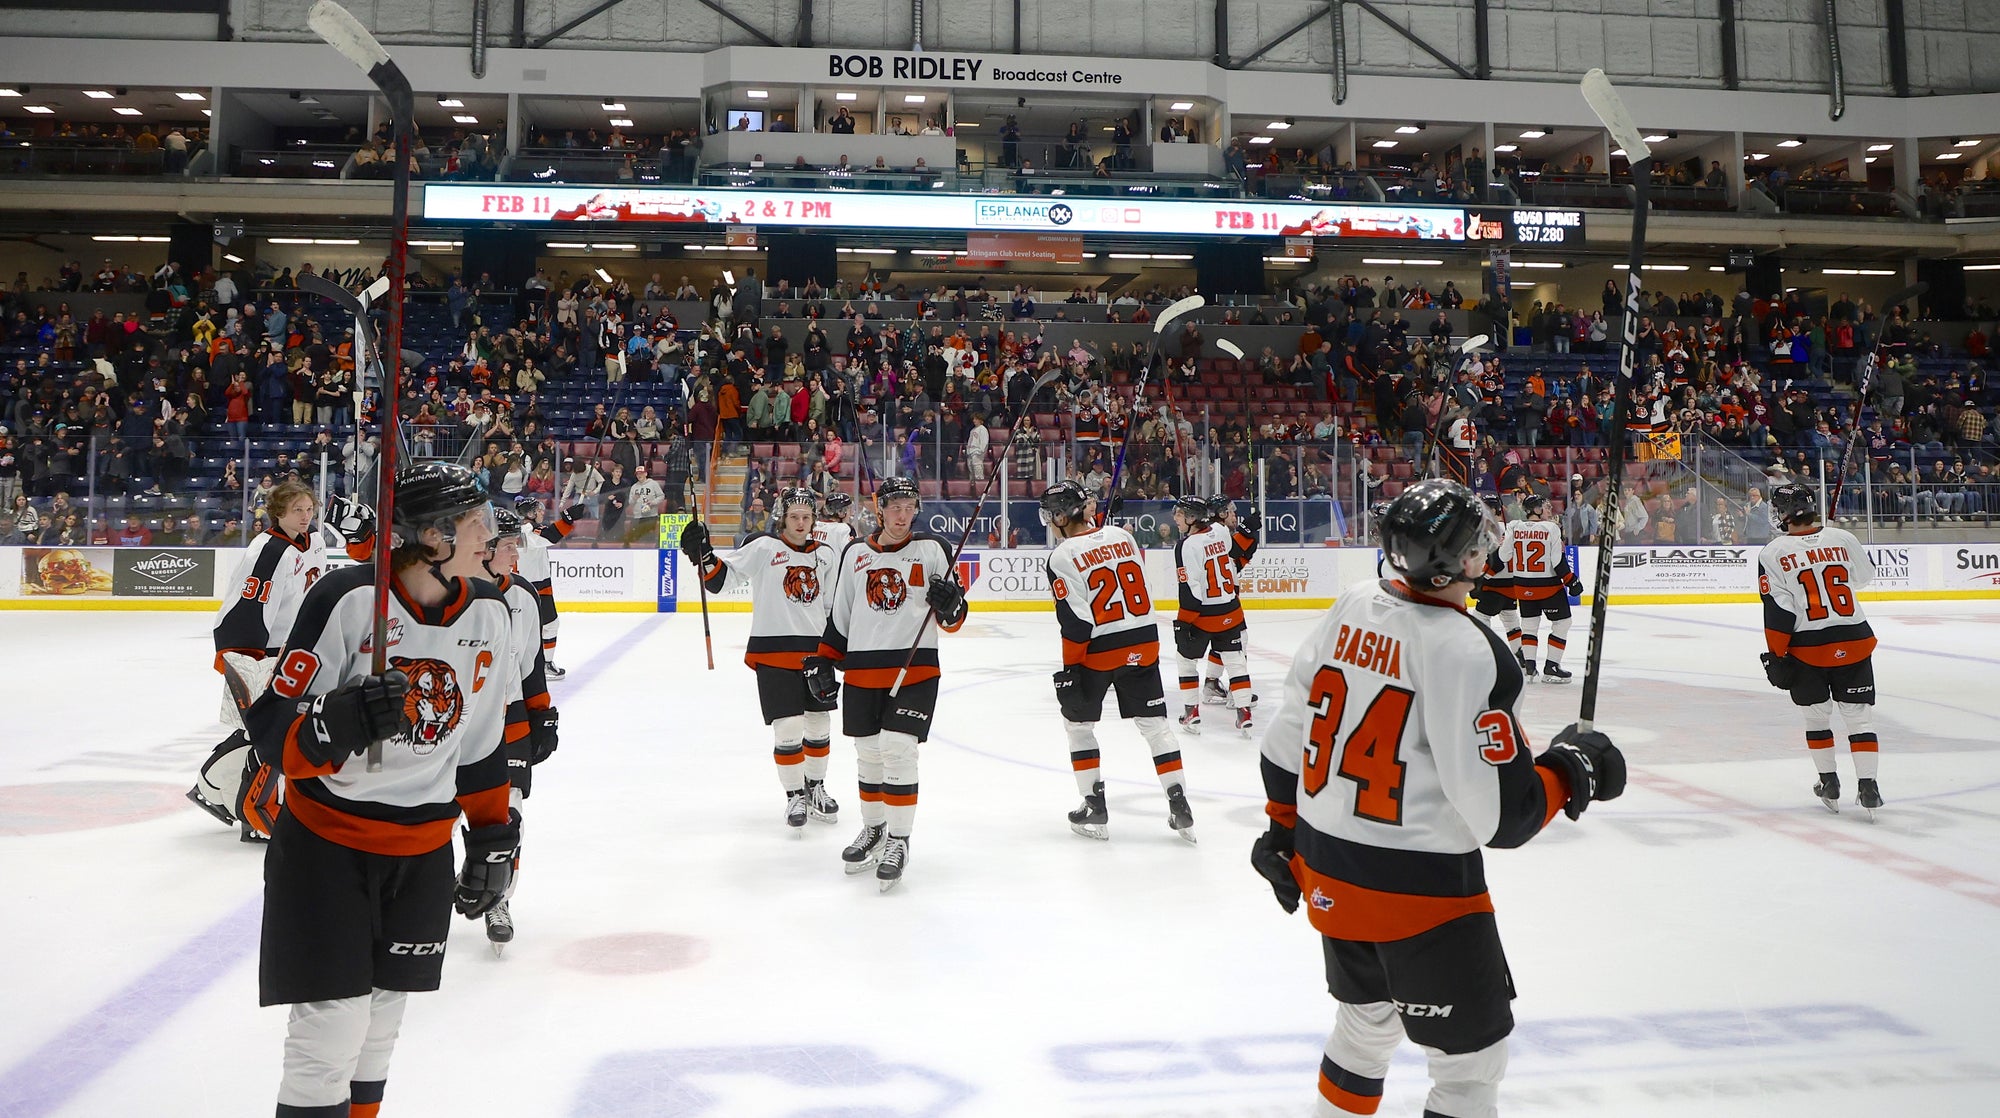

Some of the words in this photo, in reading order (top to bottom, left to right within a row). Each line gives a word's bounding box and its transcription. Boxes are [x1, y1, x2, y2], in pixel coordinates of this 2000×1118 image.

[829, 55, 884, 78] BOB
[893, 57, 983, 81] RIDLEY
[992, 68, 1068, 83] Broadcast
[1072, 69, 1123, 84] Centre
[482, 195, 529, 213] FEB
[533, 195, 550, 213] 11
[745, 200, 756, 216] 2
[762, 201, 777, 217] &
[785, 201, 796, 217] 7
[801, 201, 832, 218] PM
[981, 205, 1051, 217] ESPLANAD
[1215, 211, 1255, 230] FEB
[1262, 212, 1278, 230] 11
[1513, 211, 1543, 225] 50/50
[1544, 212, 1581, 226] UPDATE
[970, 249, 998, 258] Stringam
[1032, 250, 1056, 259] Seating
[1621, 272, 1641, 379] CCM
[661, 540, 681, 549] PUC
[1203, 540, 1227, 557] KREBS
[1597, 490, 1618, 612] JETSPEED
[1262, 557, 1285, 565] BACK
[1295, 557, 1306, 565] TO
[1513, 540, 1546, 573] 12
[1650, 549, 1747, 559] LACEY
[1779, 553, 1806, 572] ST.
[137, 558, 192, 571] WAYBACK
[549, 560, 624, 578] Thornton
[988, 557, 1048, 573] CYPR
[909, 563, 925, 588] A
[988, 576, 1052, 592] COLL
[1176, 566, 1189, 584] 5
[1204, 554, 1235, 599] 15
[242, 576, 274, 604] 31
[1052, 577, 1069, 601] 8
[1087, 560, 1151, 627] 28
[1256, 579, 1308, 593] COUNTY
[1796, 564, 1855, 622] 16
[457, 639, 489, 648] CCM
[1333, 623, 1401, 680] BASHA
[266, 646, 322, 699] 9
[472, 650, 493, 694] C
[895, 707, 928, 721] CCM
[1303, 664, 1416, 826] 34
[1473, 708, 1531, 766] 3
[388, 941, 447, 956] CCM
